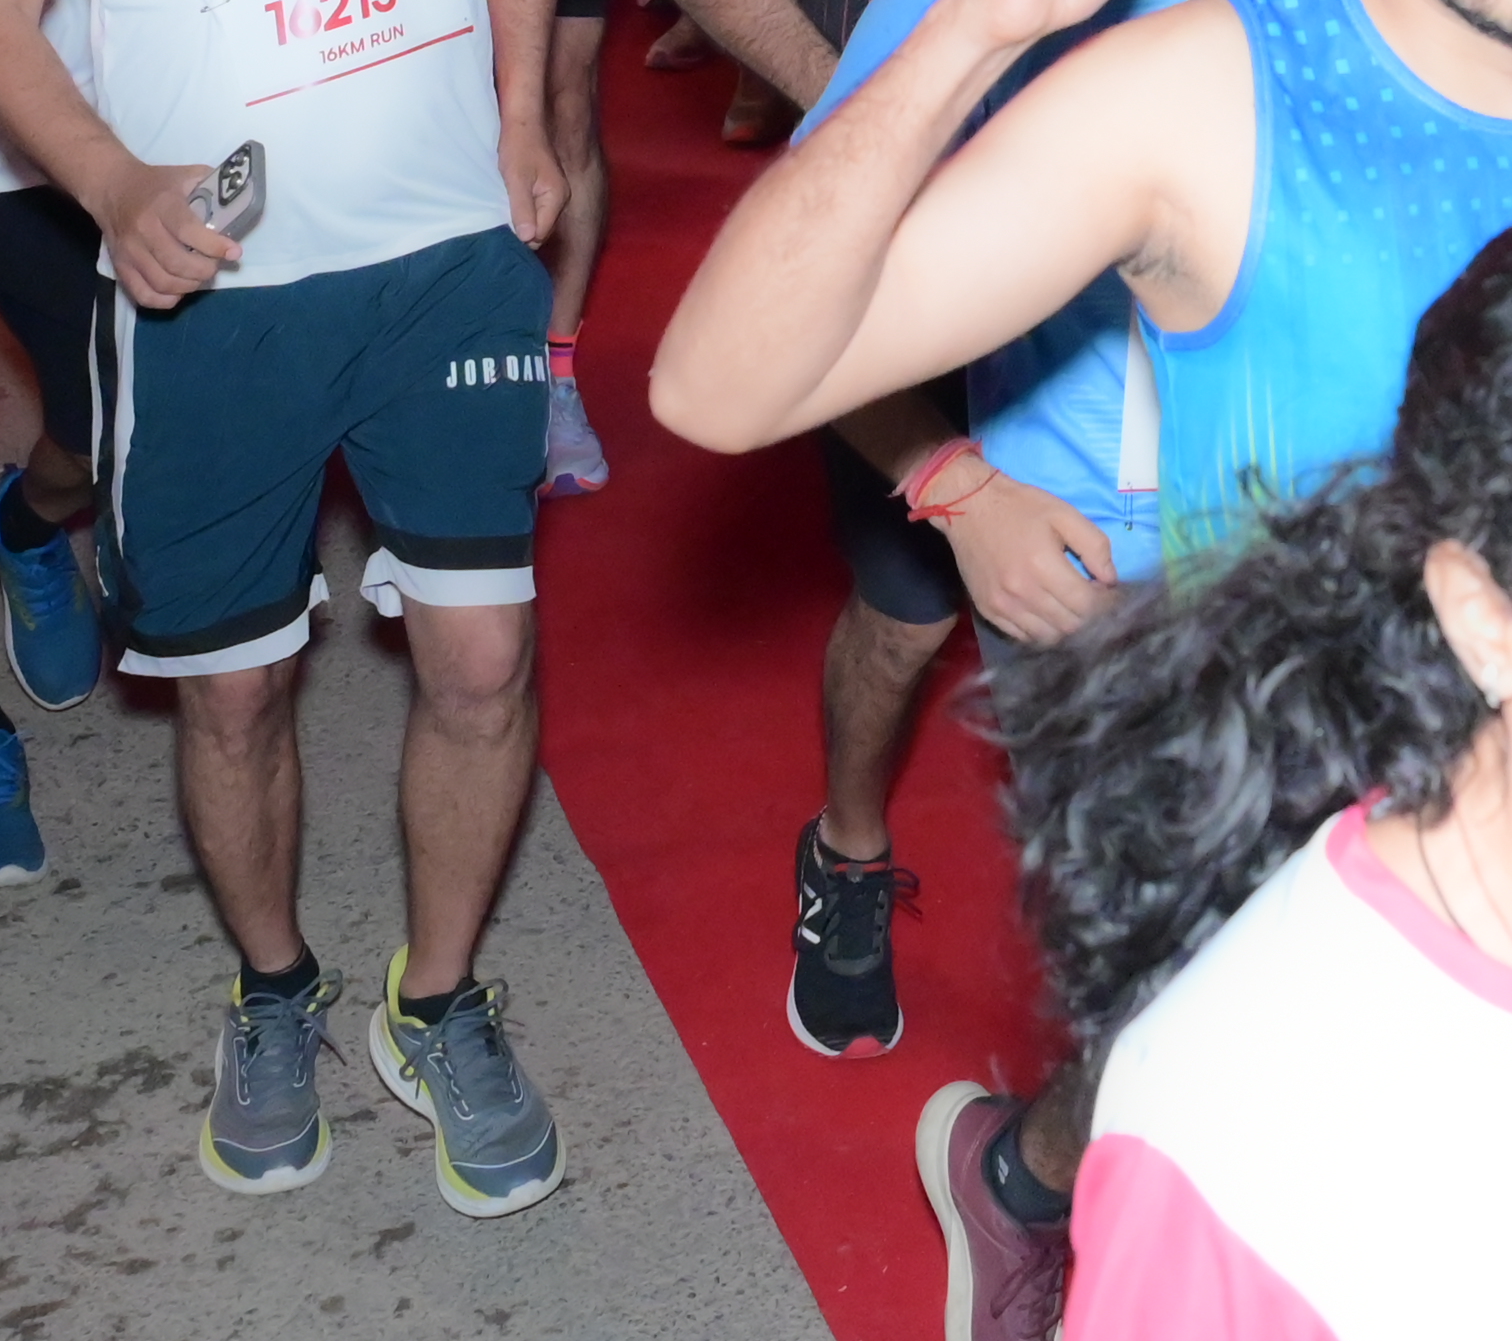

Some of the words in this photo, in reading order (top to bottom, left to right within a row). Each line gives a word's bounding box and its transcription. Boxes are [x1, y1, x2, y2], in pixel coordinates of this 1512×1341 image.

[319, 37, 366, 65] 16KM
[370, 23, 405, 49] RUN
[445, 354, 547, 389] JORDAN
